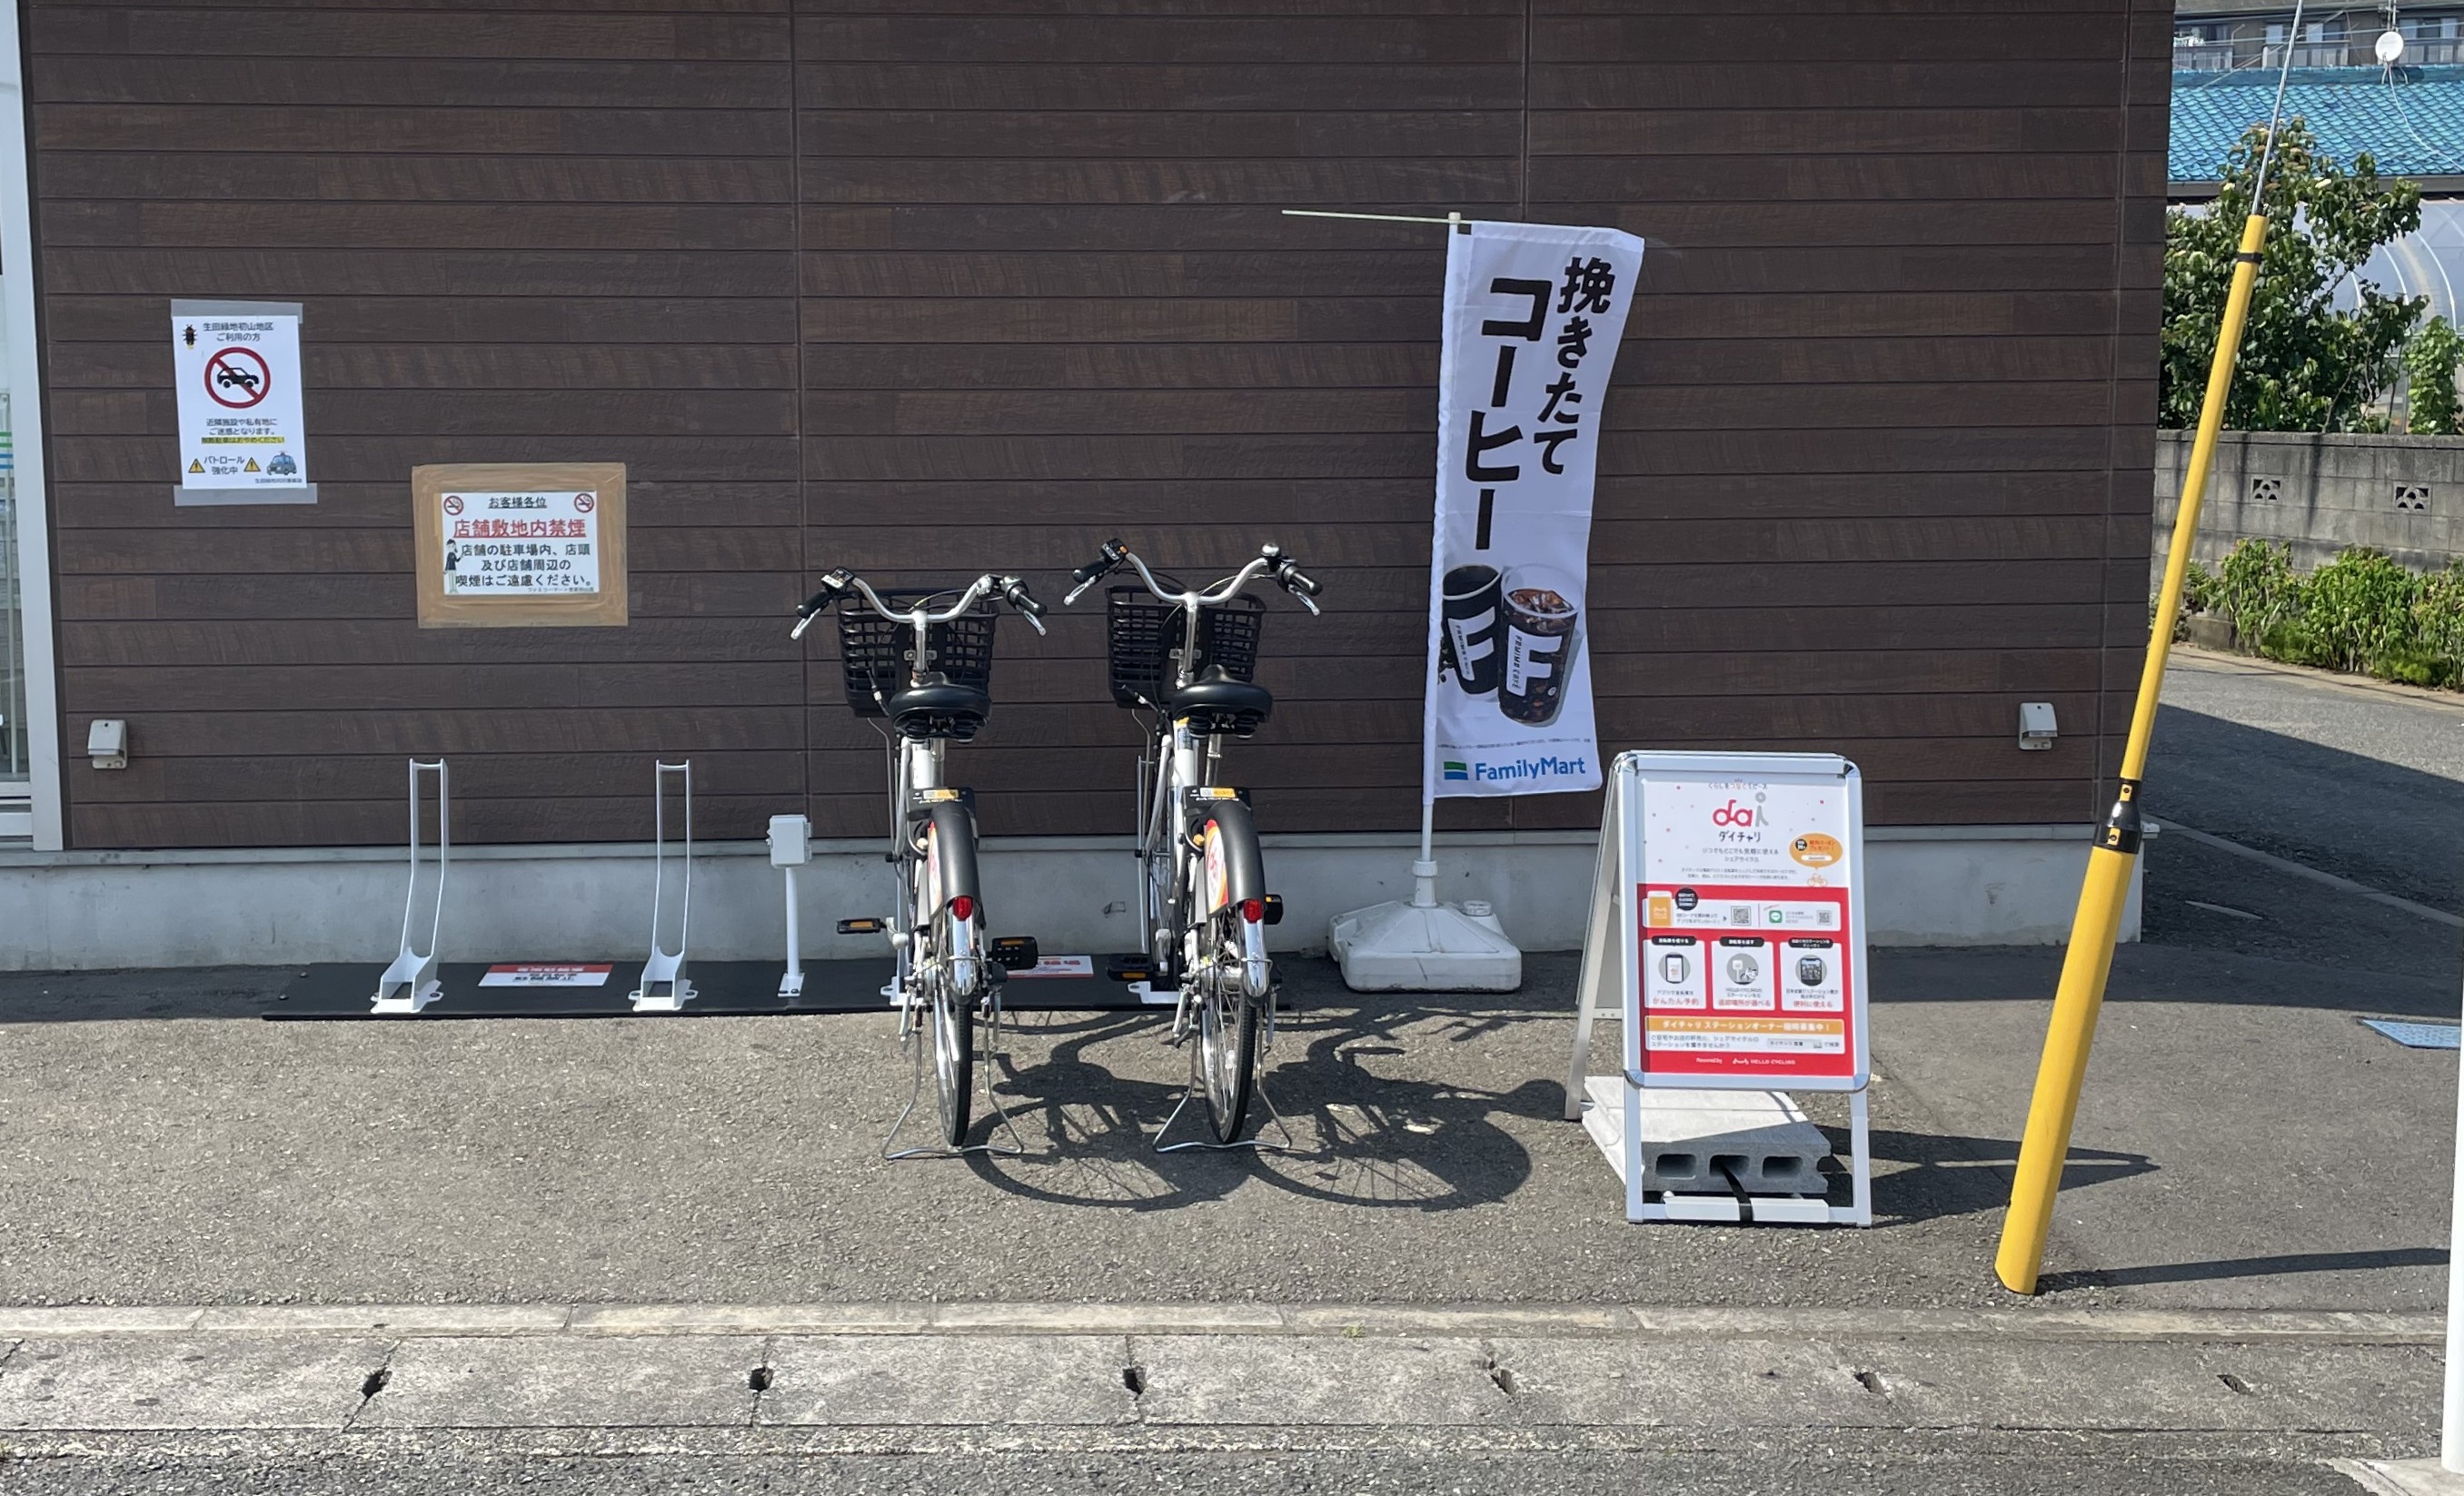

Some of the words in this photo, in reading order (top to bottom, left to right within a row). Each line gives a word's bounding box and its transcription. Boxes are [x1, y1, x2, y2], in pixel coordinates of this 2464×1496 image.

[216, 332, 261, 342] ご利用の方
[1532, 256, 1615, 475] 挽きたて
[1465, 276, 1553, 550] コーヒー
[206, 418, 278, 427] 近隣施設や私有地に
[209, 428, 275, 436] ご迷惑となります。
[204, 456, 245, 464] パトロール
[211, 466, 238, 475] 強化中
[488, 496, 548, 509] お客様各位
[454, 519, 587, 538] 店舗敷地内禁煙
[461, 543, 591, 556] 店舗の駐車場内、店頭
[481, 559, 571, 571] 及び店舗周辺の
[455, 574, 592, 588] 喫煙はご遠慮ください。
[1475, 757, 1586, 781] FamilyMart
[1712, 791, 1770, 827] dai
[1718, 830, 1762, 843] ダイチャリ
[1663, 1020, 1702, 1029] ダイチャリ
